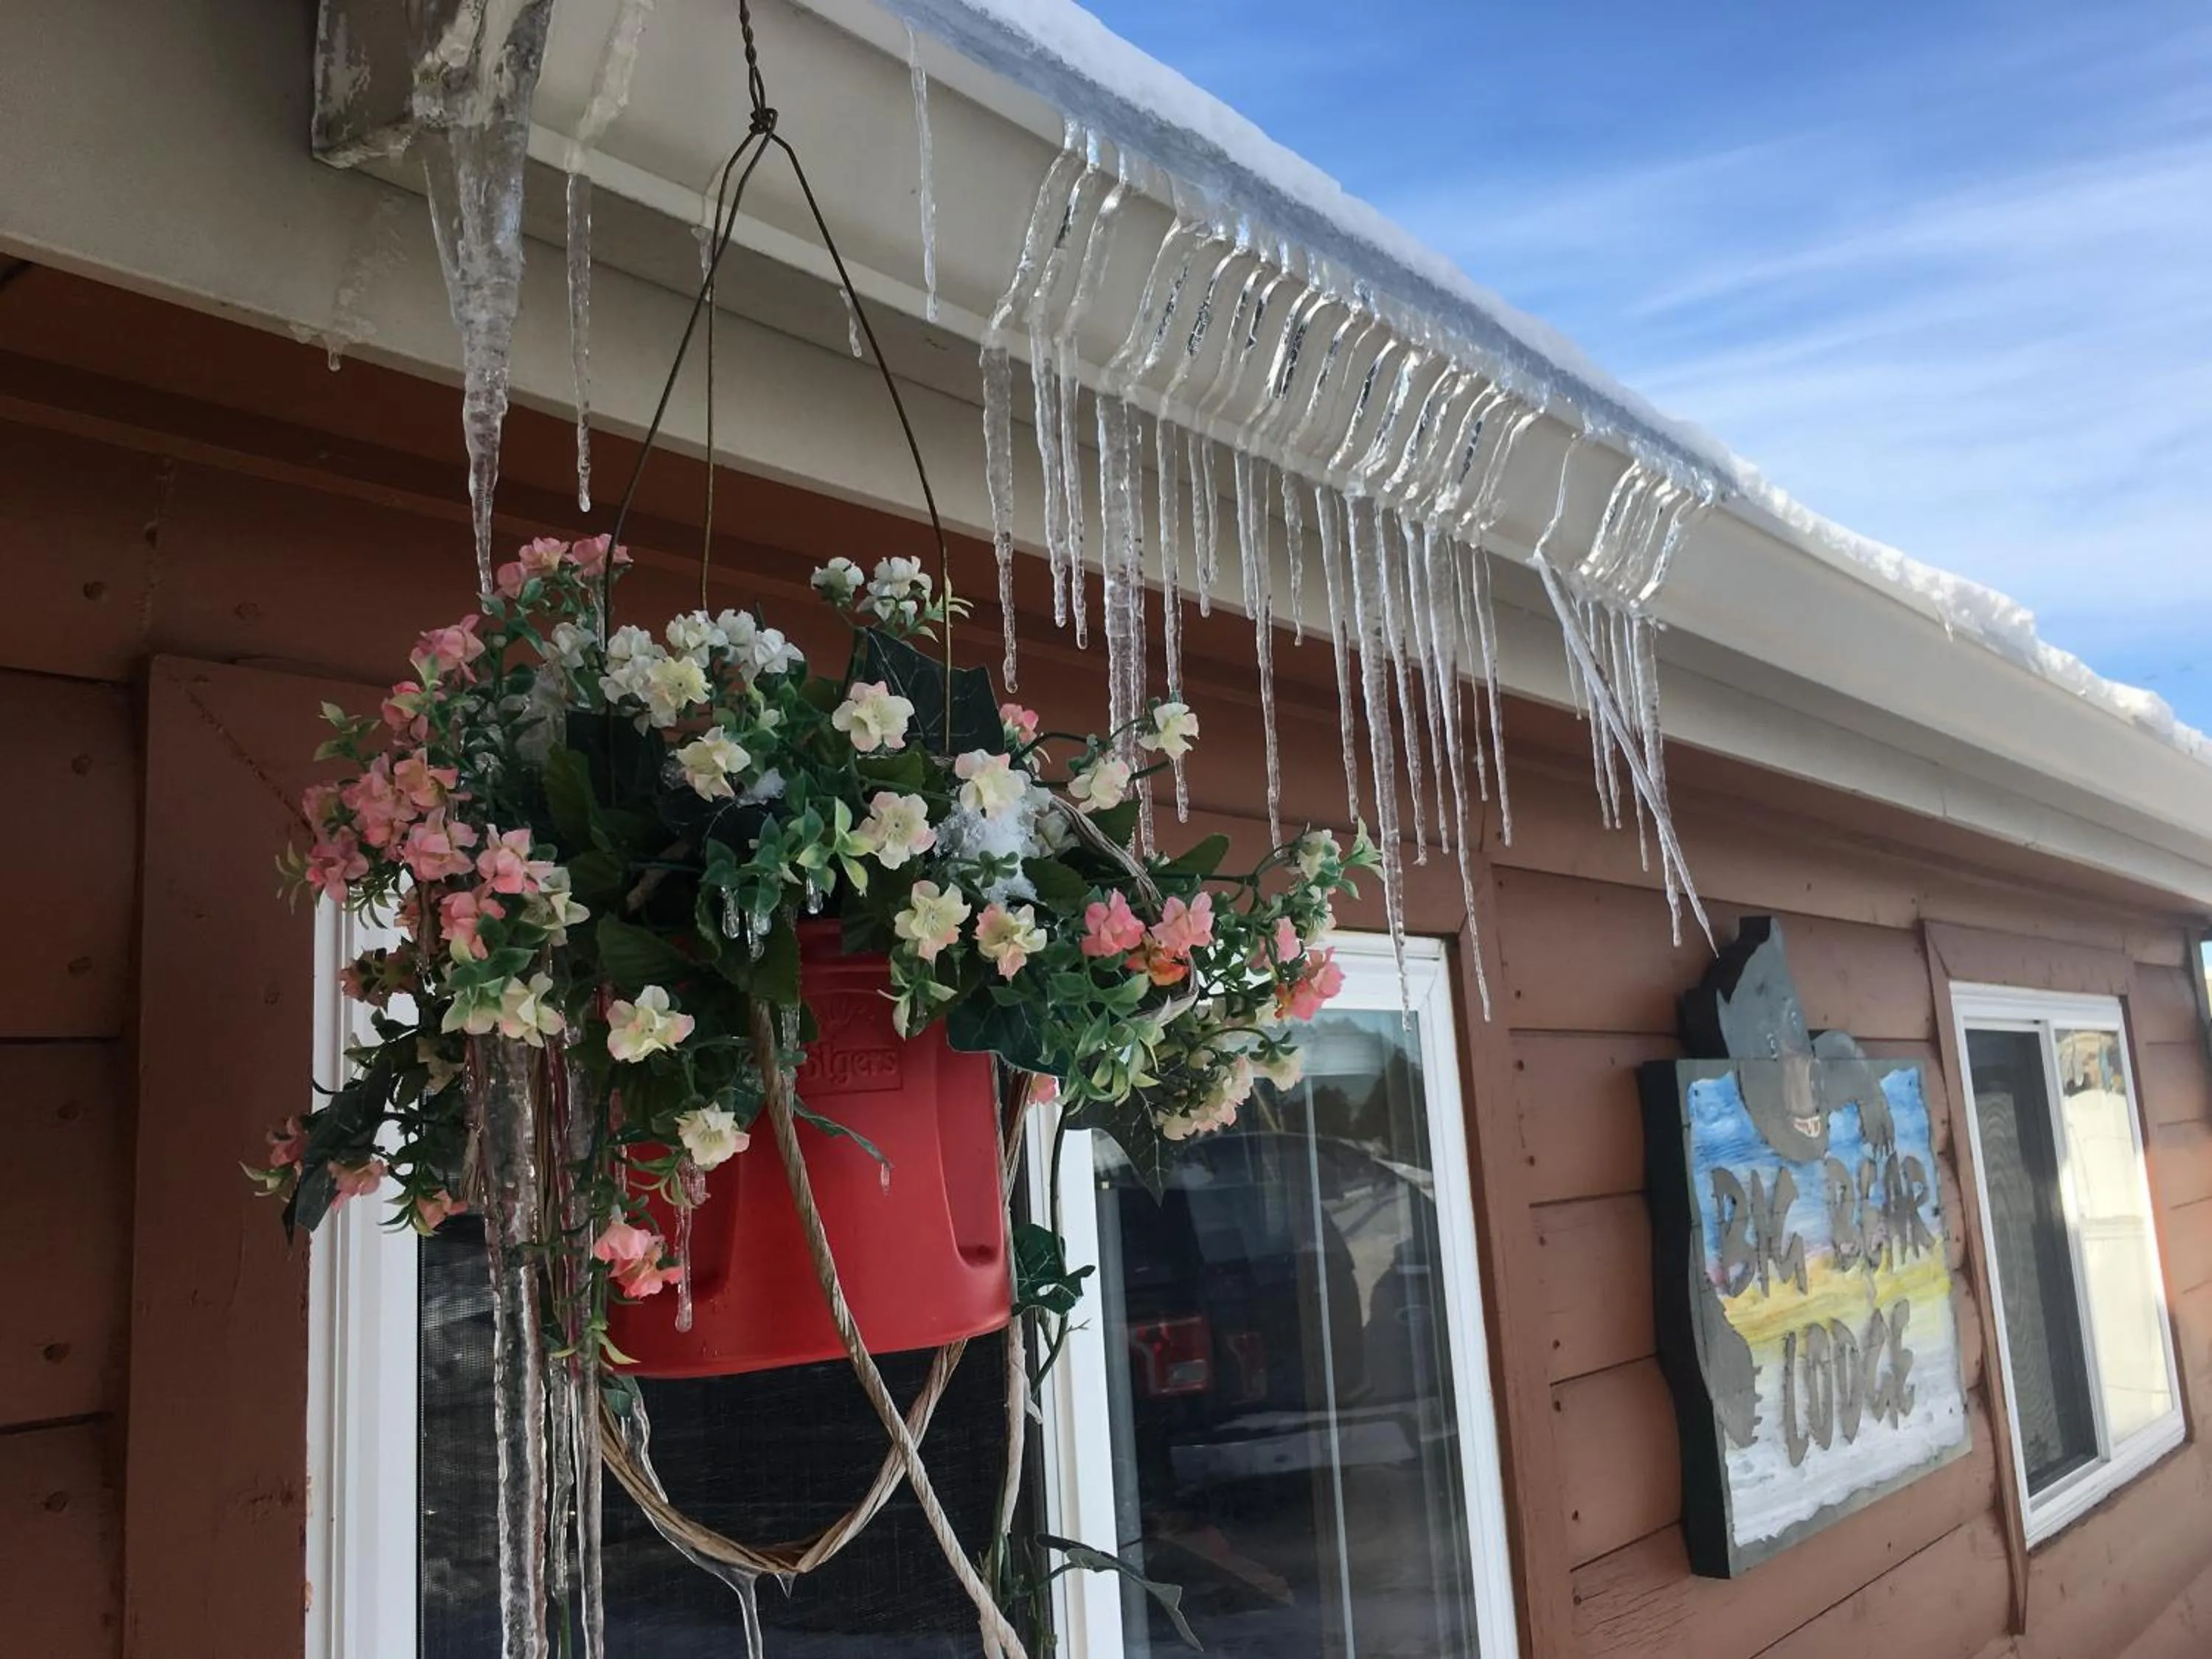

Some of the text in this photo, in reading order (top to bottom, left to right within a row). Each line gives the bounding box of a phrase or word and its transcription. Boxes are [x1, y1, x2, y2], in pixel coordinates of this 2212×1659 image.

[801, 1043, 898, 1086] olgers
[1711, 1151, 1936, 1298] BIG BEAR
[1782, 1298, 1916, 1467] LODGE
